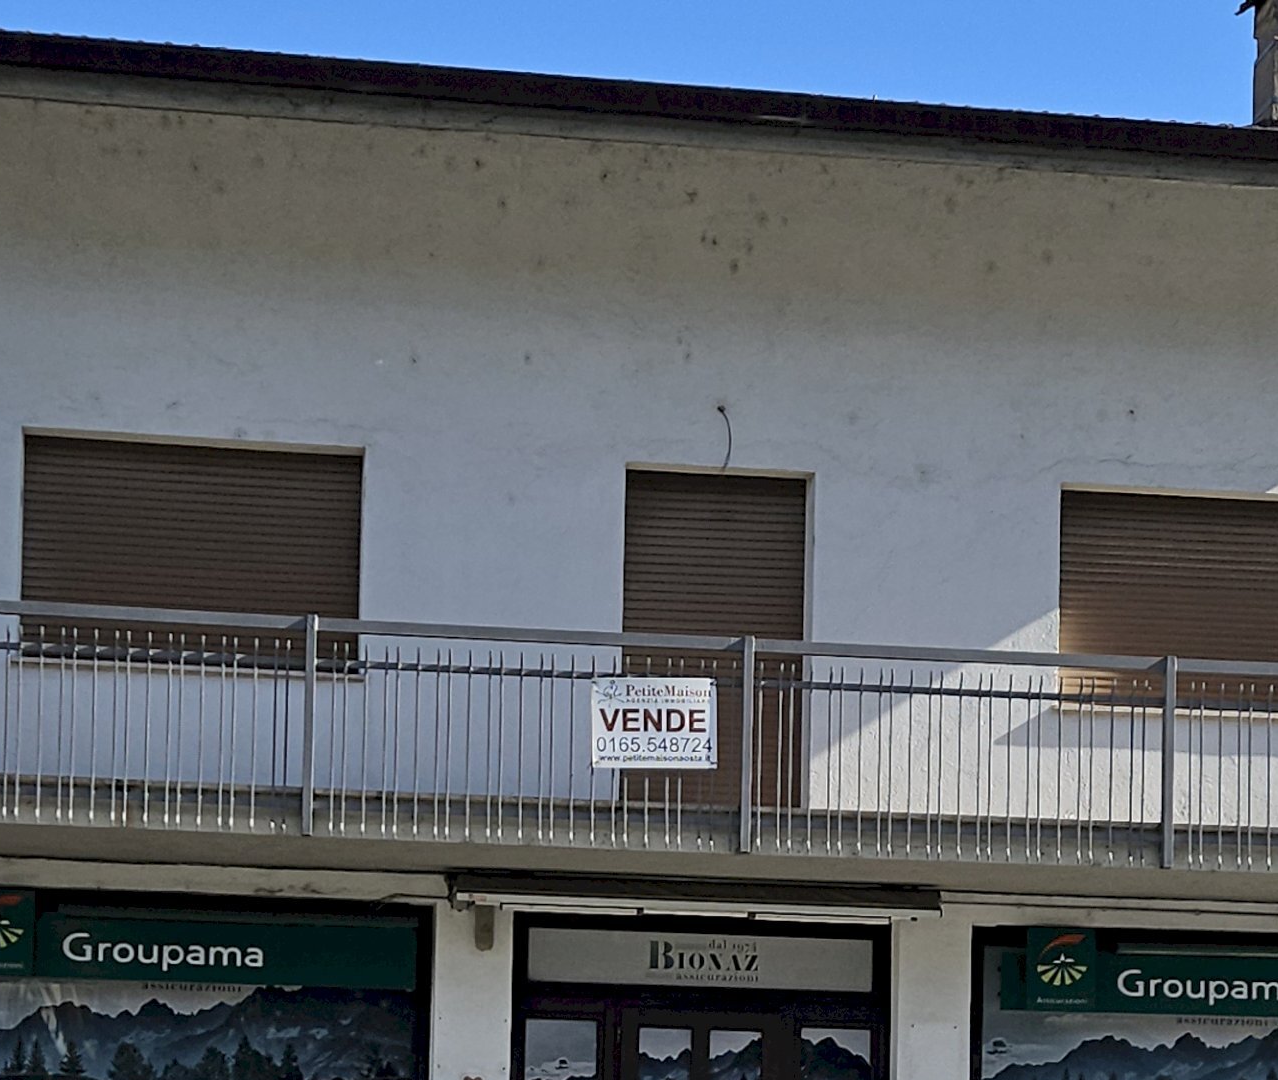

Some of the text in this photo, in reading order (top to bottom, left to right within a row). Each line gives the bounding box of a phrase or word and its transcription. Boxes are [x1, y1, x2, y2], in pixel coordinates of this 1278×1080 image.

[599, 708, 707, 733] VENDE
[596, 736, 713, 753] 0165.548724
[62, 932, 265, 972] Groupama
